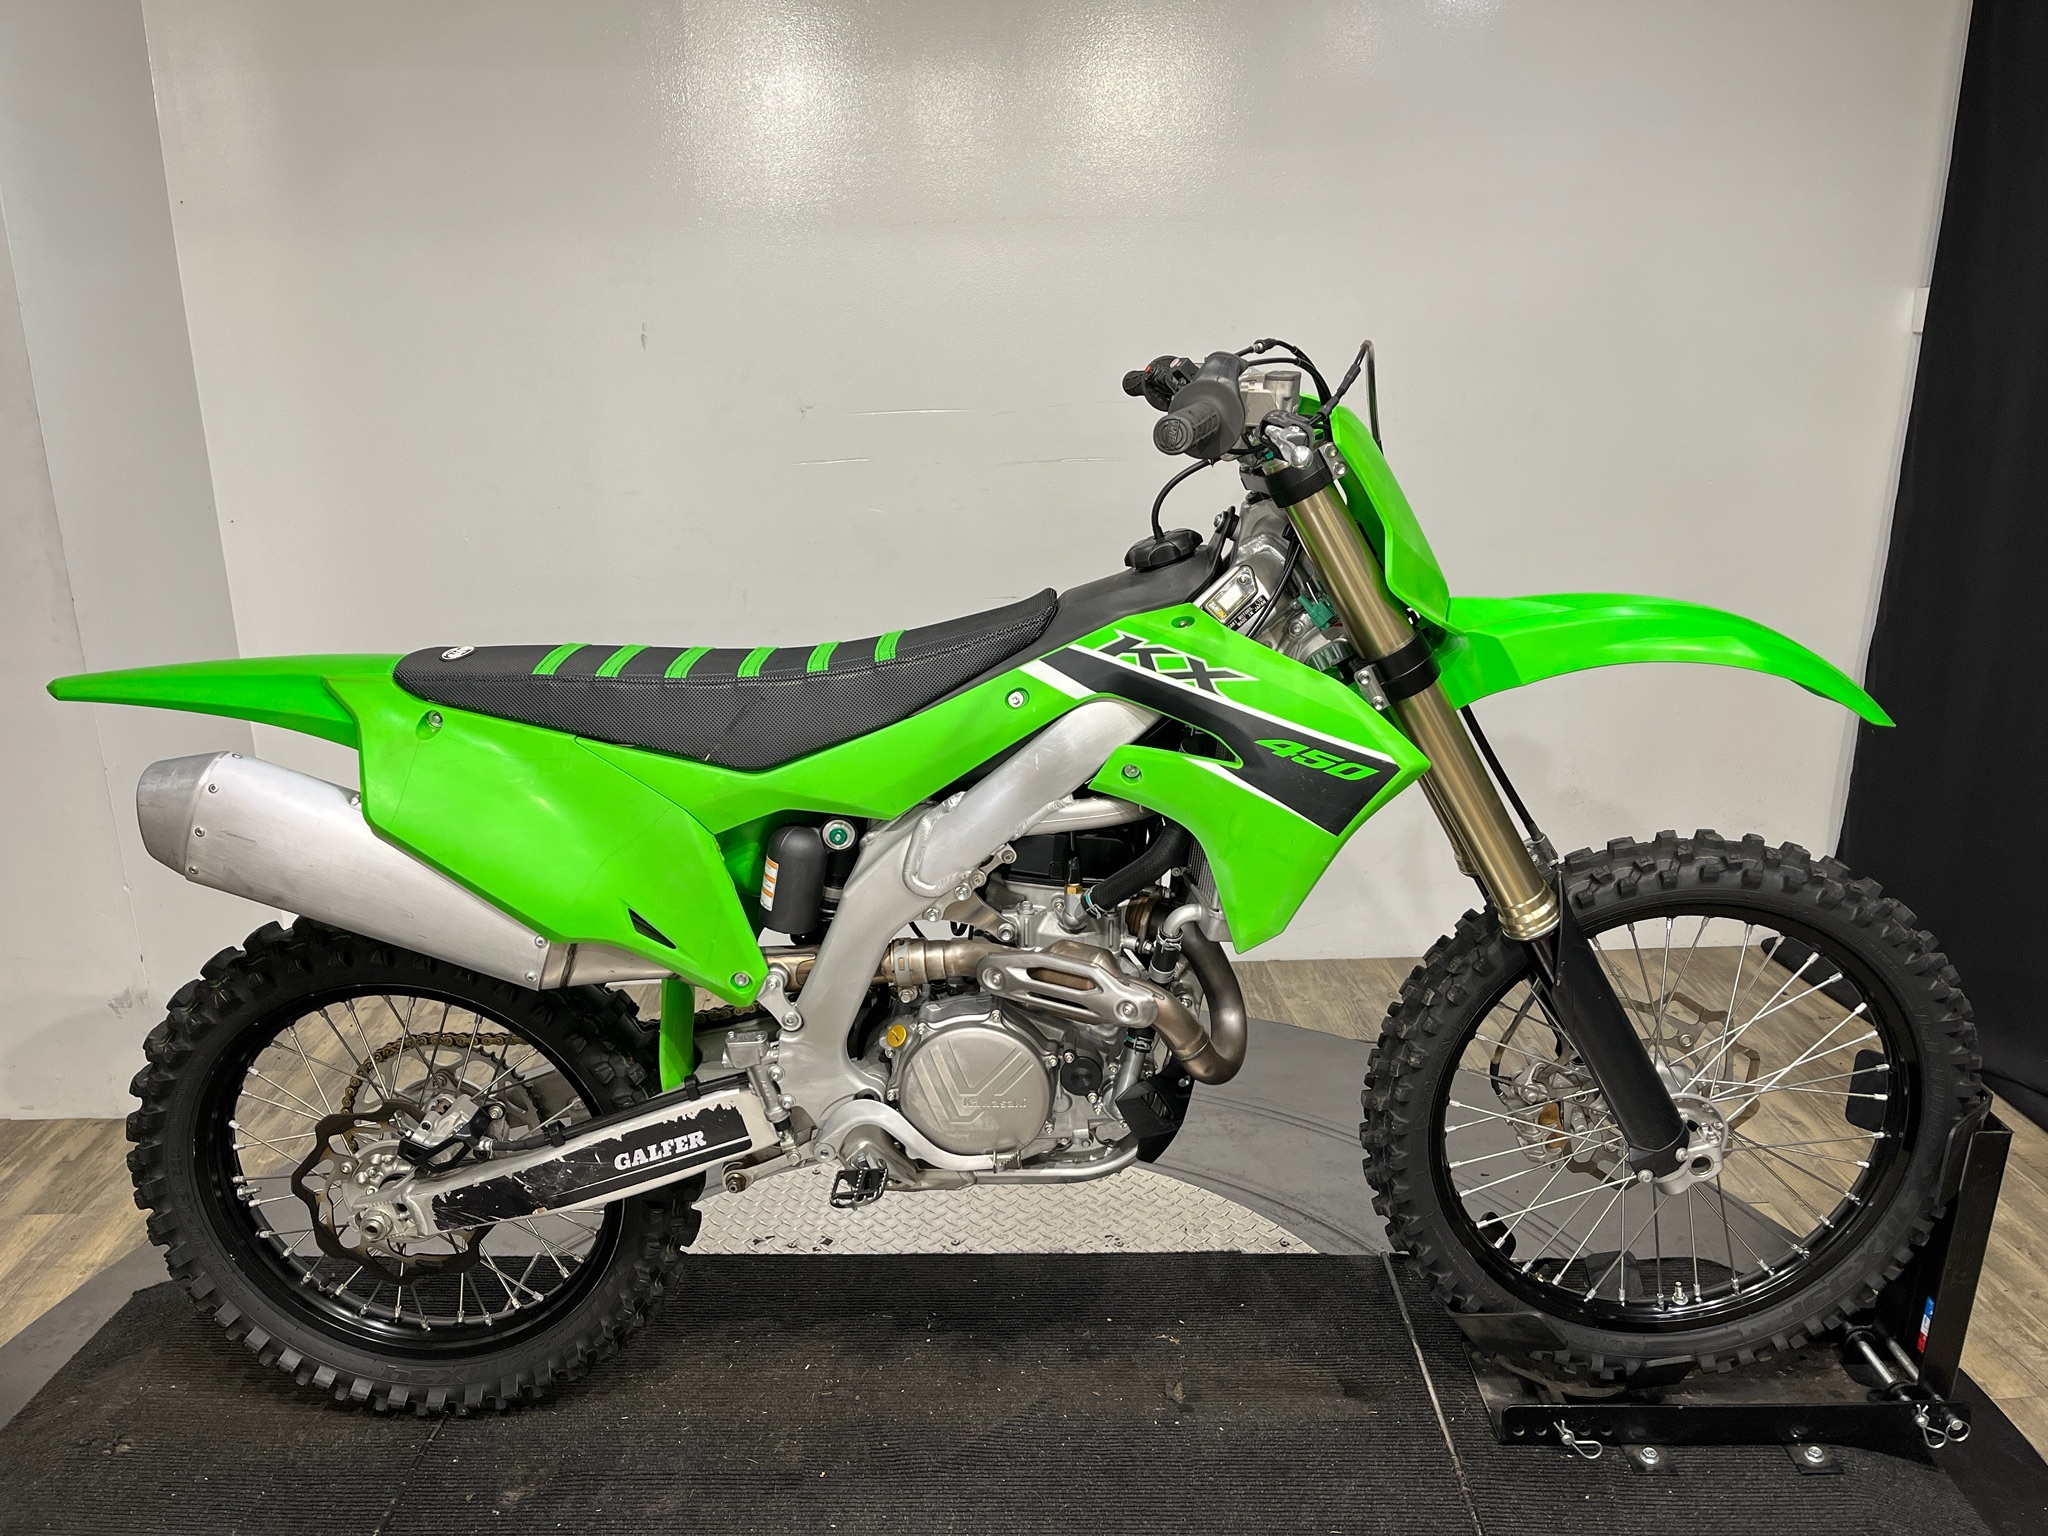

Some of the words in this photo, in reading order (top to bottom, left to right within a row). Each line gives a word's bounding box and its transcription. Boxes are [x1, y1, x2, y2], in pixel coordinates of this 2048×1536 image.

[1099, 630, 1256, 699] KX
[1254, 738, 1381, 781] 450
[962, 1097, 1027, 1109] Kawasaki
[613, 1130, 707, 1171] GALFER
